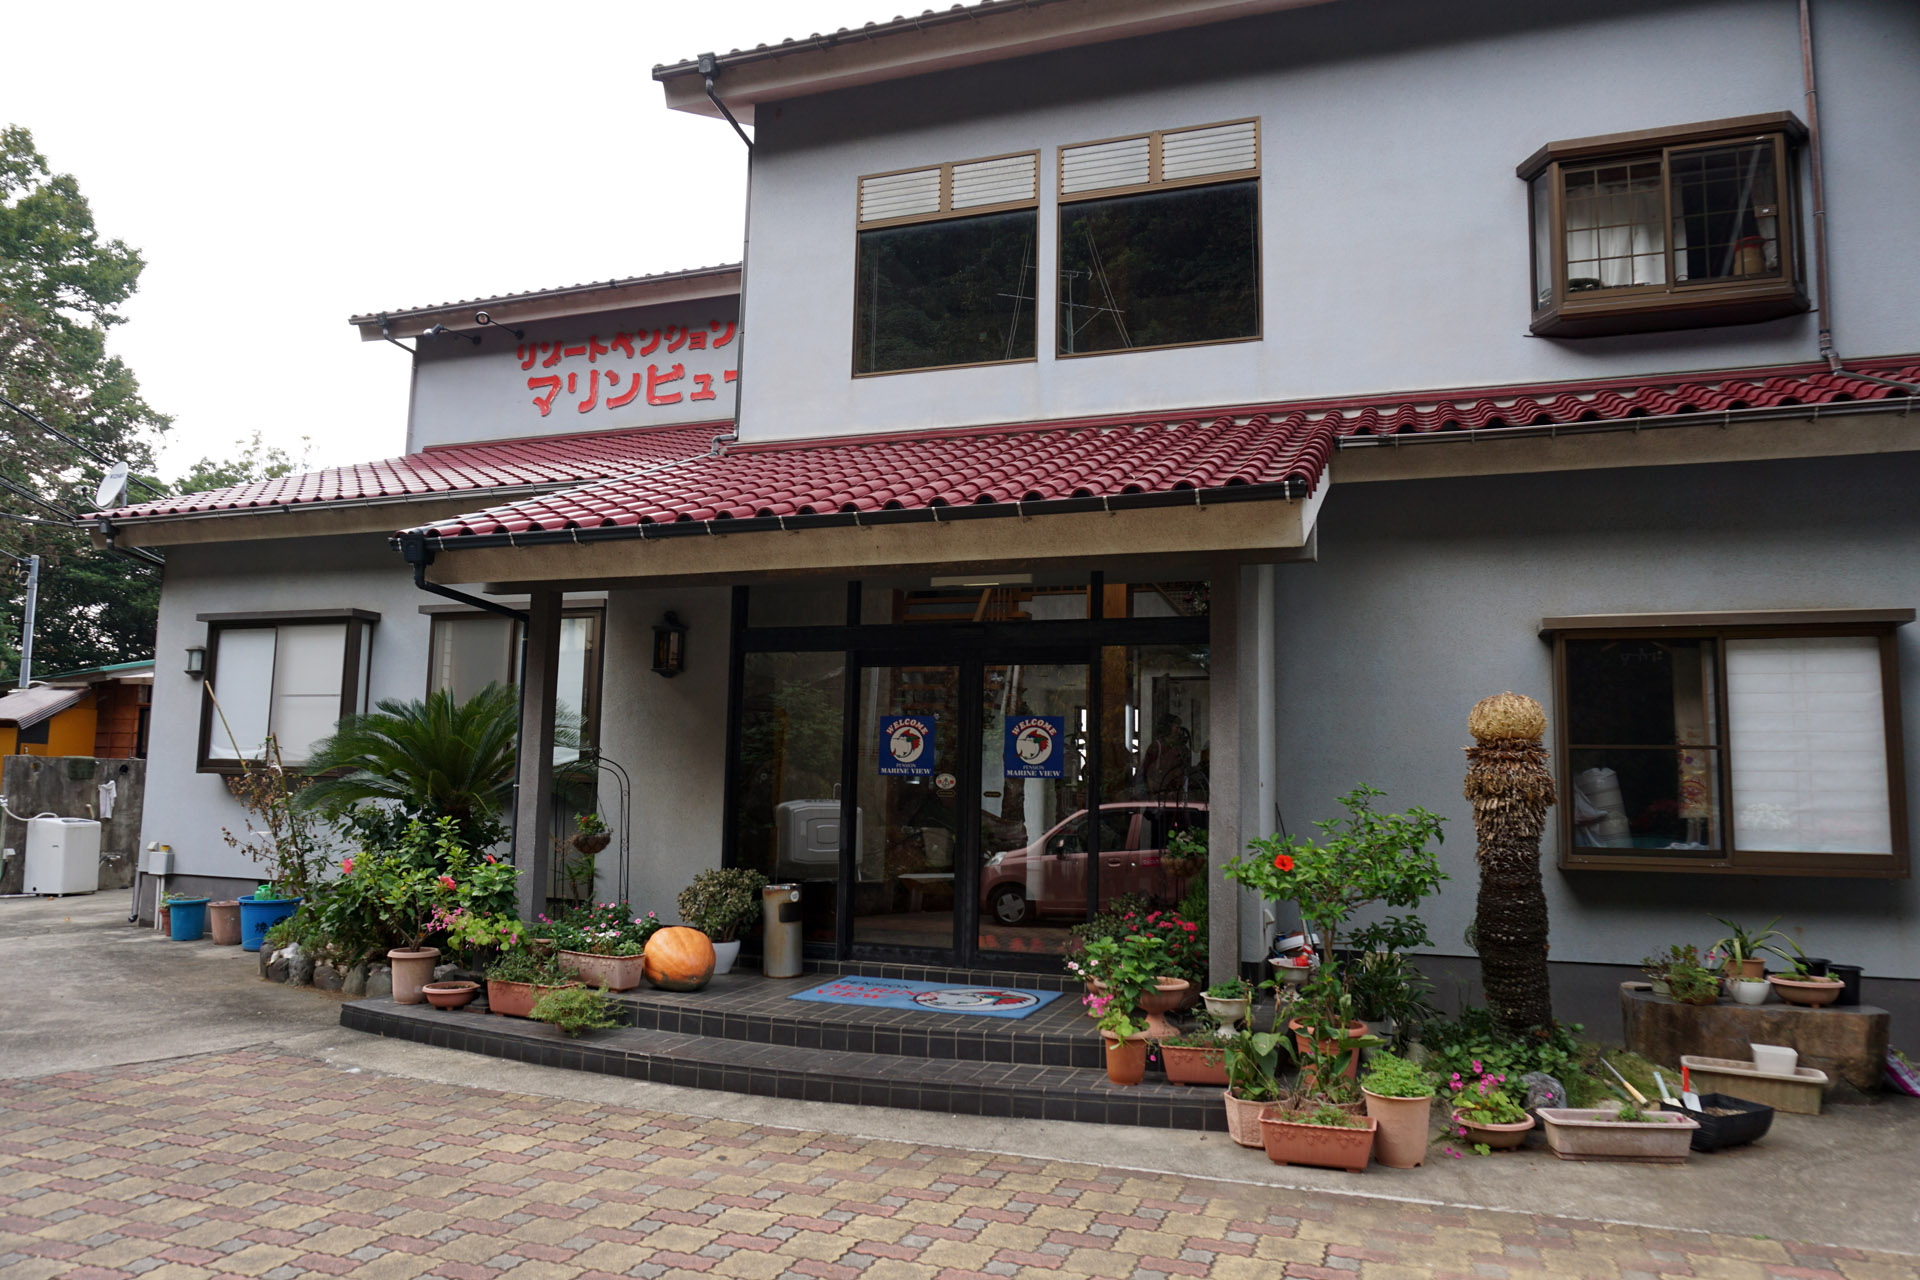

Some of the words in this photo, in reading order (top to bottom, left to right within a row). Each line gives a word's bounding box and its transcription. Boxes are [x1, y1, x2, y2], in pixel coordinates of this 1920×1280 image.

[517, 320, 735, 370] リゾートペンション
[886, 718, 928, 735] WELCOME
[1011, 718, 1056, 735] WELCOME
[818, 989, 887, 999] VIEW
[827, 984, 941, 997] MARINE
